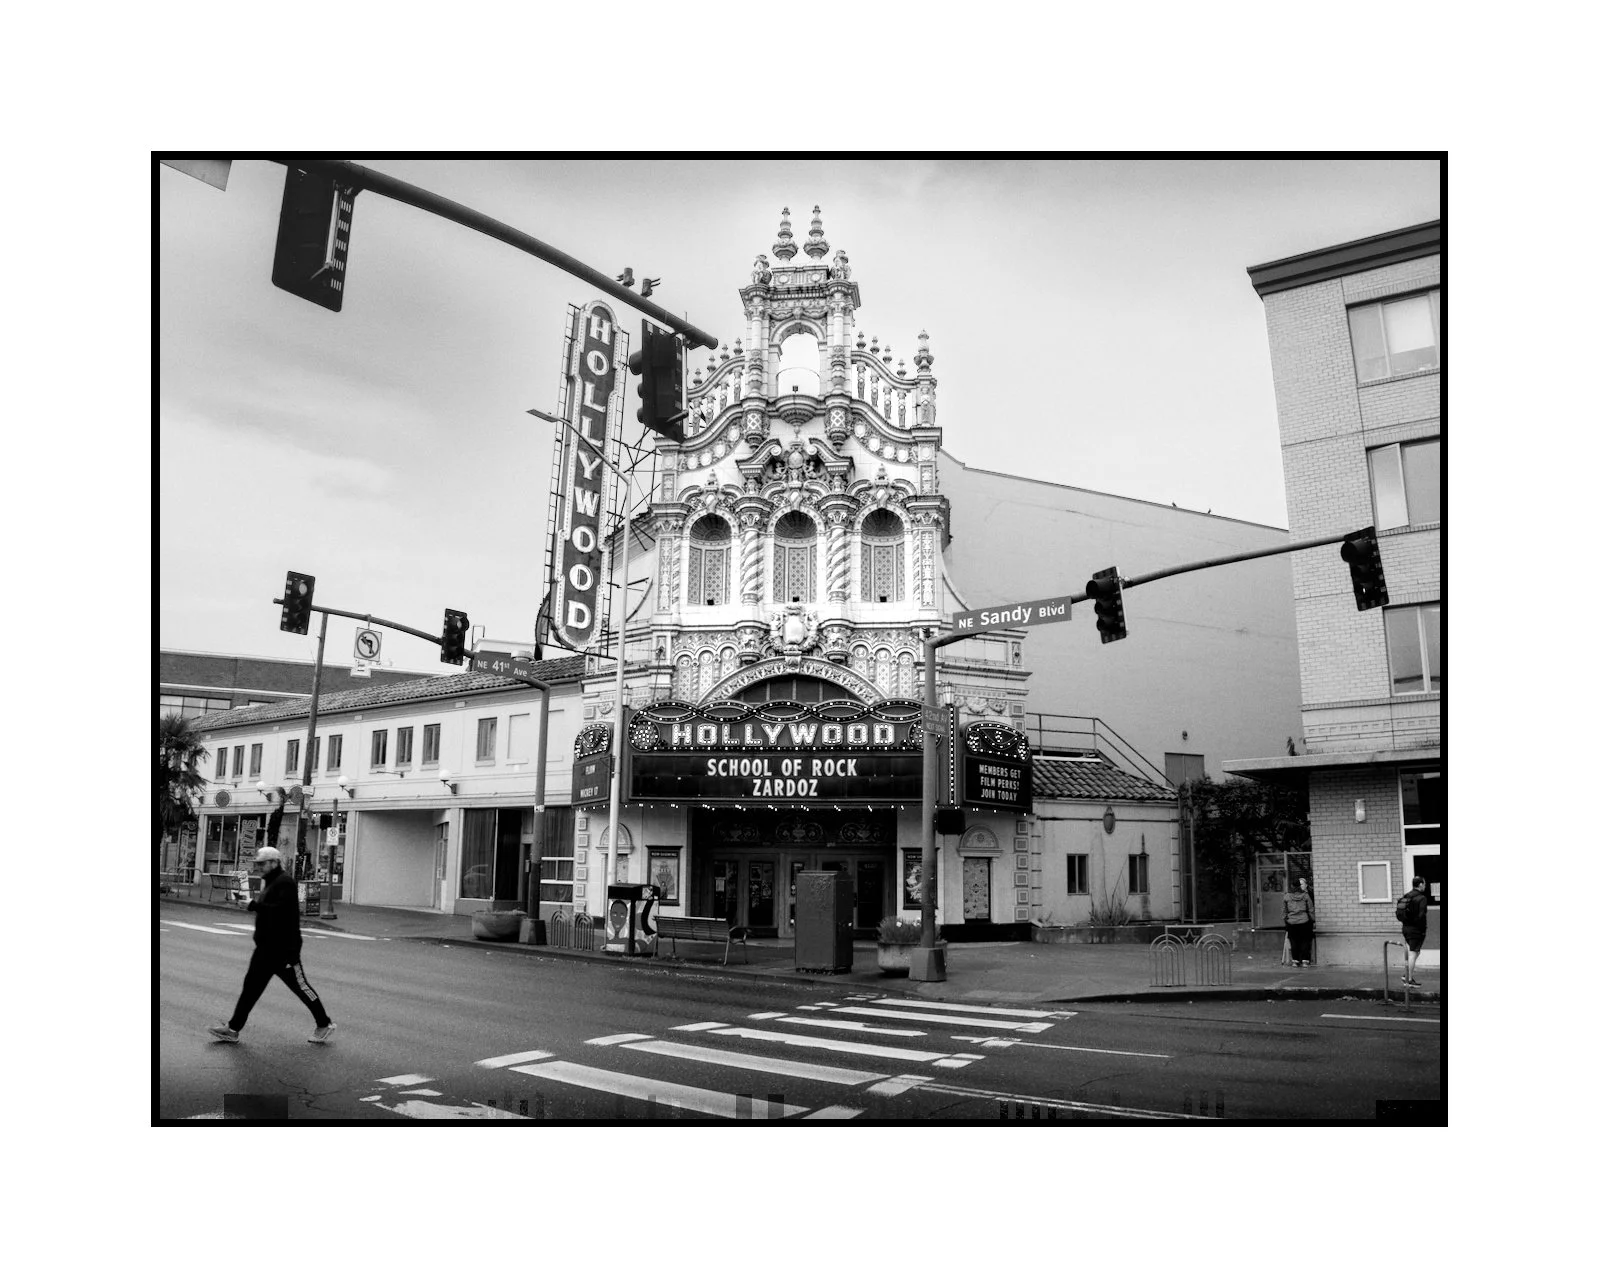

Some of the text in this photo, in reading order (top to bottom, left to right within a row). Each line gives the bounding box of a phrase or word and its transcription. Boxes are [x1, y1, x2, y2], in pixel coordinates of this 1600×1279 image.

[566, 314, 611, 629] HOLLYWOOD
[958, 604, 1065, 628] NE Sandy Blvd
[477, 660, 528, 677] NE 41st Ave
[671, 723, 895, 746] HOLLYWOOD
[707, 758, 857, 777] SCHOOL OF ROCK
[979, 764, 1022, 779] MEMBERS GET
[752, 778, 818, 797] ZARDOZ
[980, 776, 1020, 790] FILM PERKS!
[980, 788, 1018, 801] JOIN TODAY
